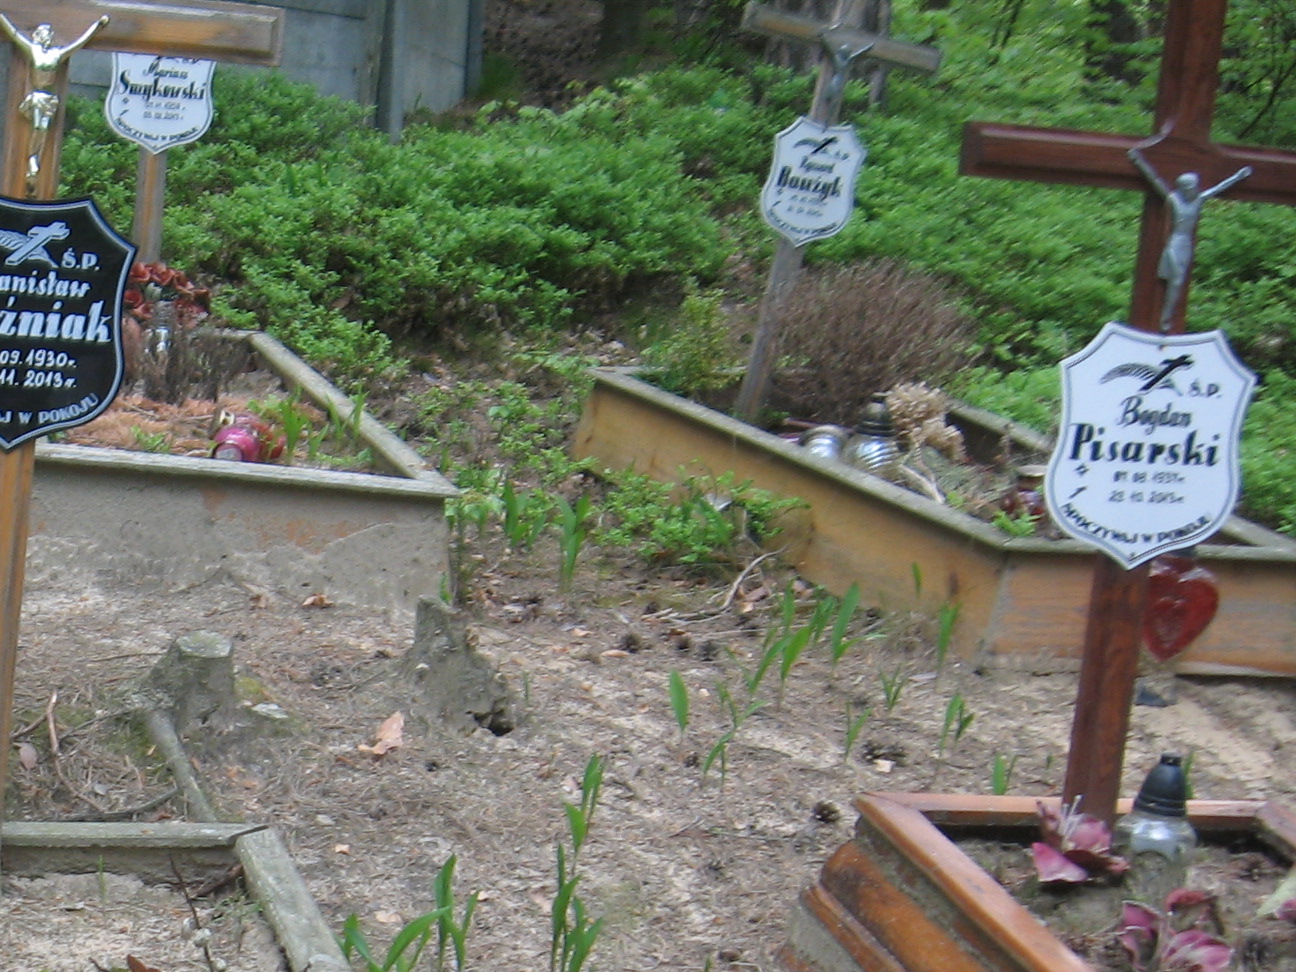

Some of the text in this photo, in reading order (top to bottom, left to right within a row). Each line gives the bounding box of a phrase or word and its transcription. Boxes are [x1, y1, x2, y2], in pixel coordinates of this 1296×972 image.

[61, 247, 101, 271] Ś.P.
[17, 410, 32, 425] W
[37, 392, 100, 425] POKOJU
[1117, 395, 1193, 435] Bogdan
[1068, 422, 1220, 468] Pisarski
